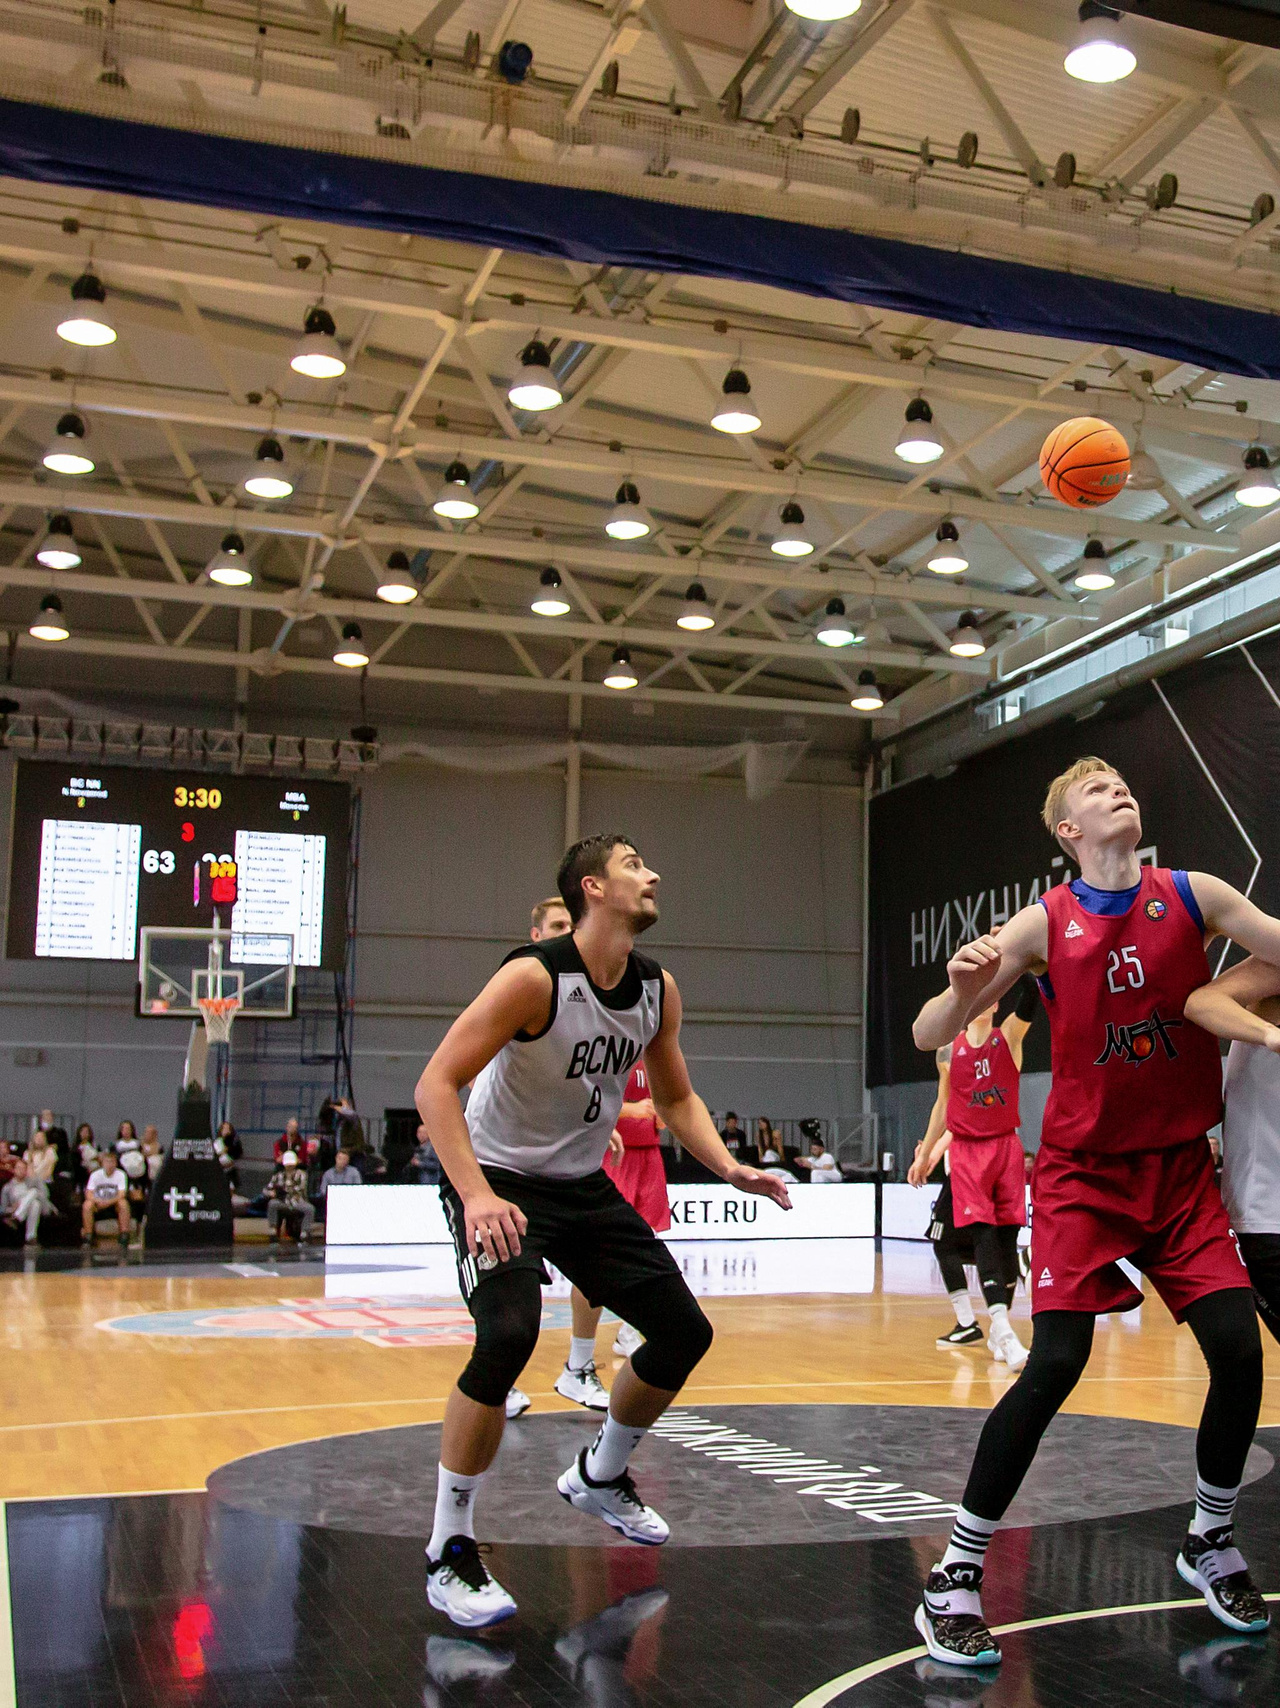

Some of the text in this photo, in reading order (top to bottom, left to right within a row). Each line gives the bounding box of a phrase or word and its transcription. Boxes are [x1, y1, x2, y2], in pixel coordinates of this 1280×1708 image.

[174, 786, 222, 809] 3:30
[181, 822, 195, 842] 3
[143, 850, 176, 874] 63
[1106, 944, 1146, 994] 25
[565, 1034, 643, 1080] BCNN
[635, 1068, 646, 1088] 11
[583, 1085, 602, 1123] 8
